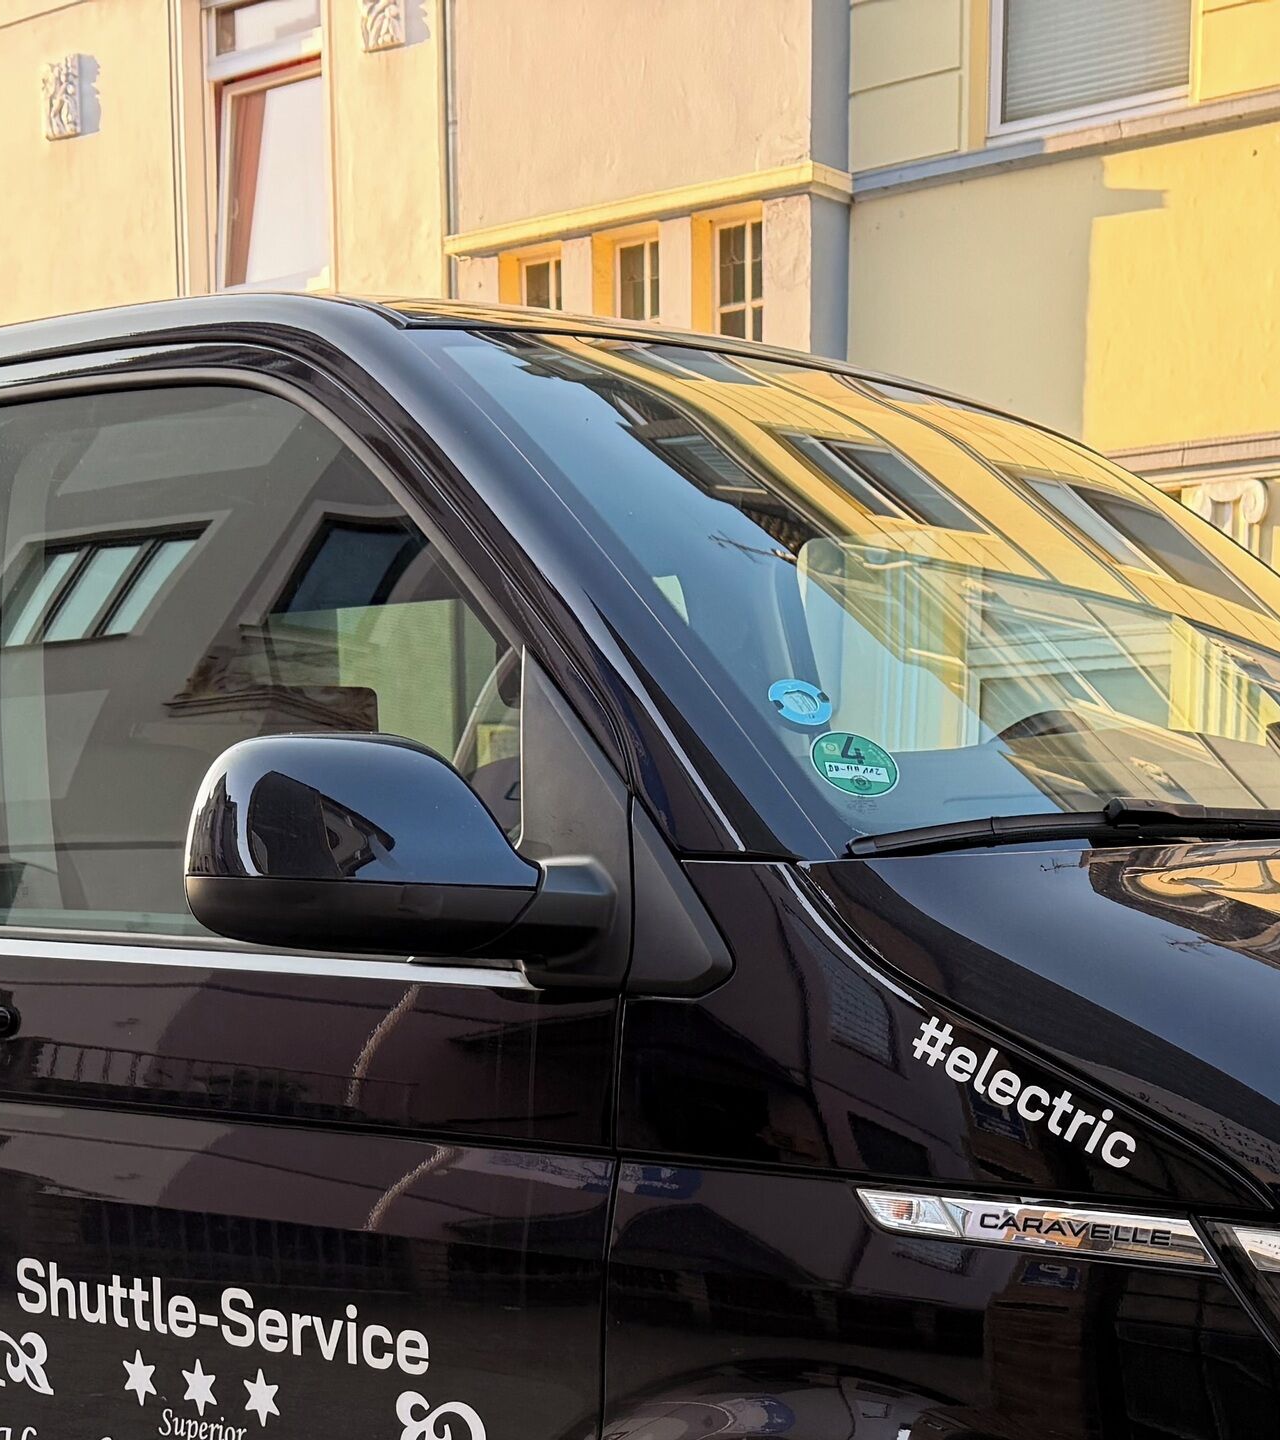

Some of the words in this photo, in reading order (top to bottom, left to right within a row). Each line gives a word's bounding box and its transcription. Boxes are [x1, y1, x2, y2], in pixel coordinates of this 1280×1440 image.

[840, 736, 866, 765] 4
[911, 1015, 1137, 1169] #electric
[979, 1212, 1173, 1247] CARAVELLE
[16, 1257, 430, 1375] Shuttle-Service
